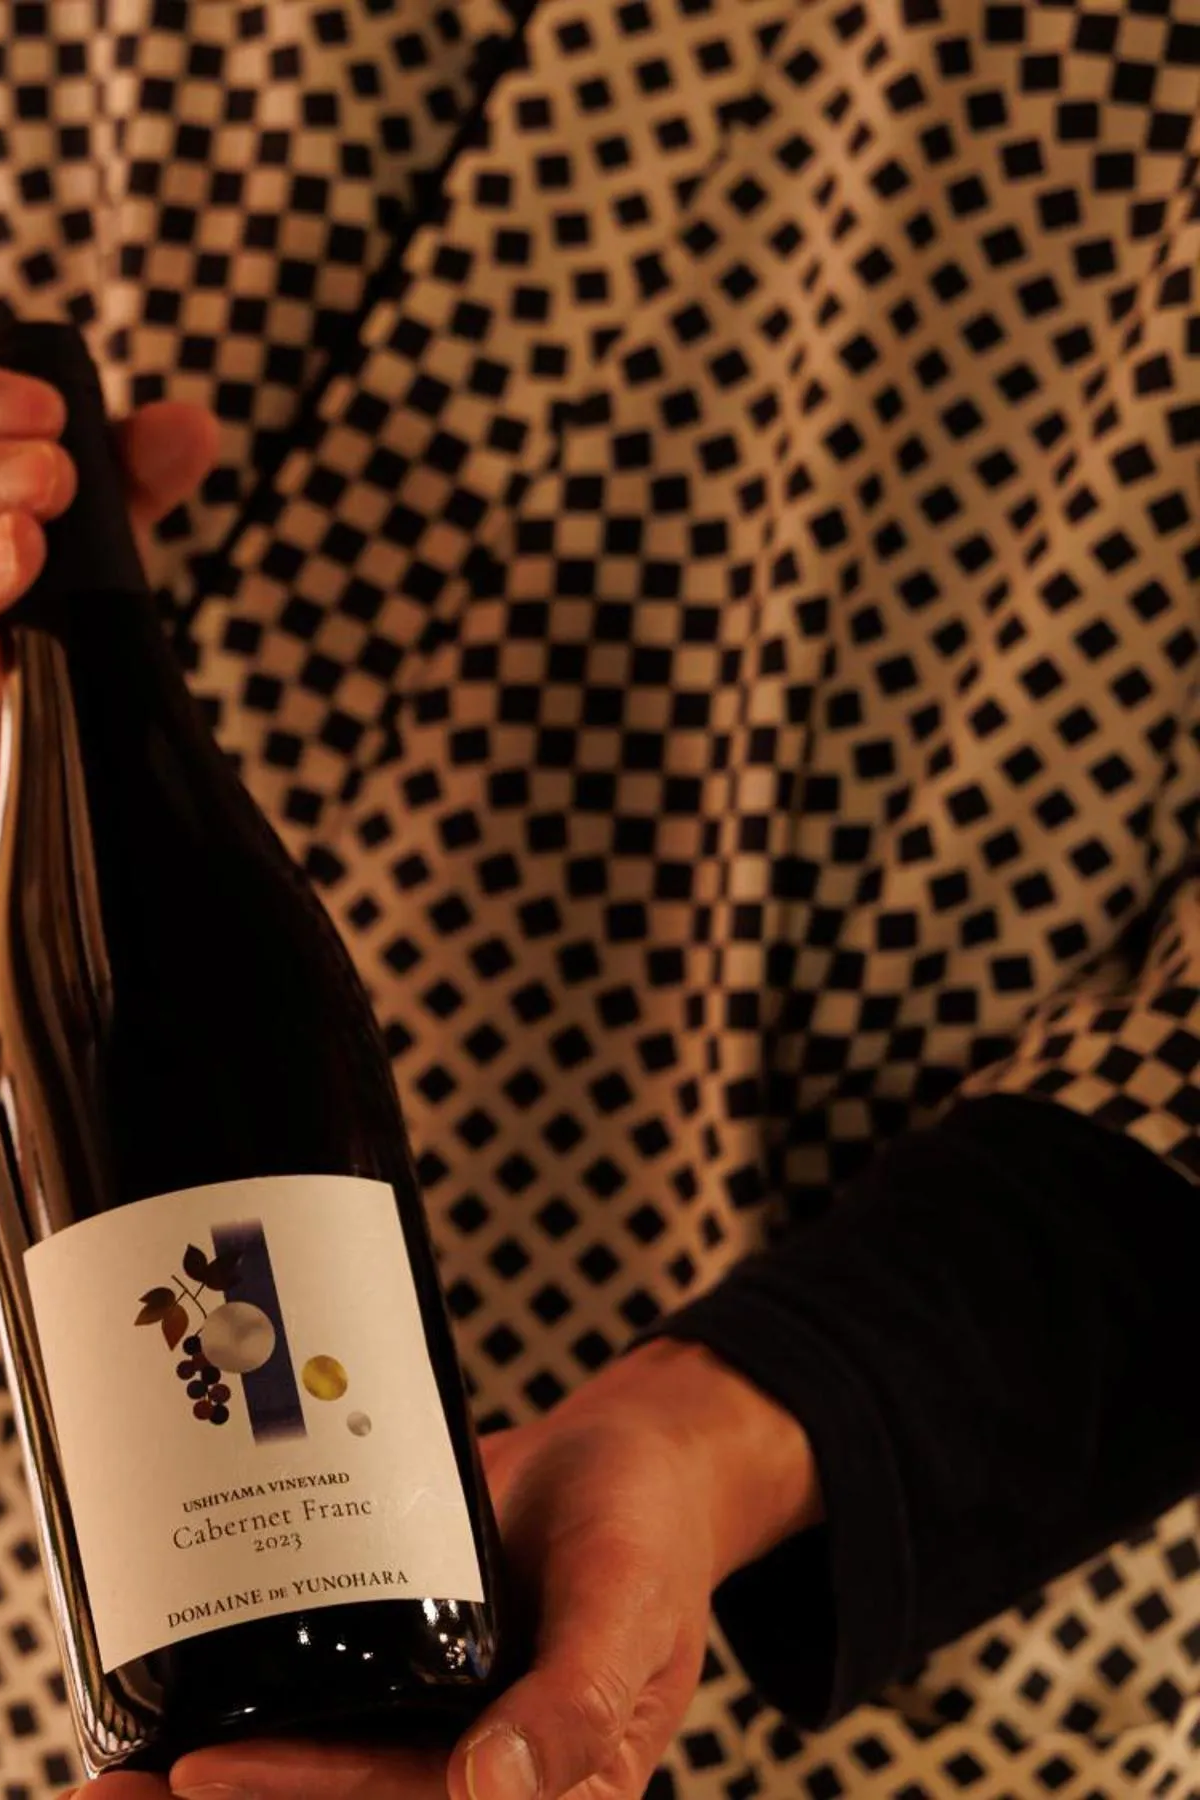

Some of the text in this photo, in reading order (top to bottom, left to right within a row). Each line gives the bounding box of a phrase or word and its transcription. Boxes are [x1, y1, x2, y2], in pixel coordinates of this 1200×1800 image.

[182, 1472, 350, 1513] USHIYAMA VINEYARD
[173, 1498, 373, 1550] Cabernet Franc
[253, 1532, 303, 1552] 2023
[167, 1588, 264, 1628] DOMAINE
[292, 1570, 409, 1596] YUNOHARA
